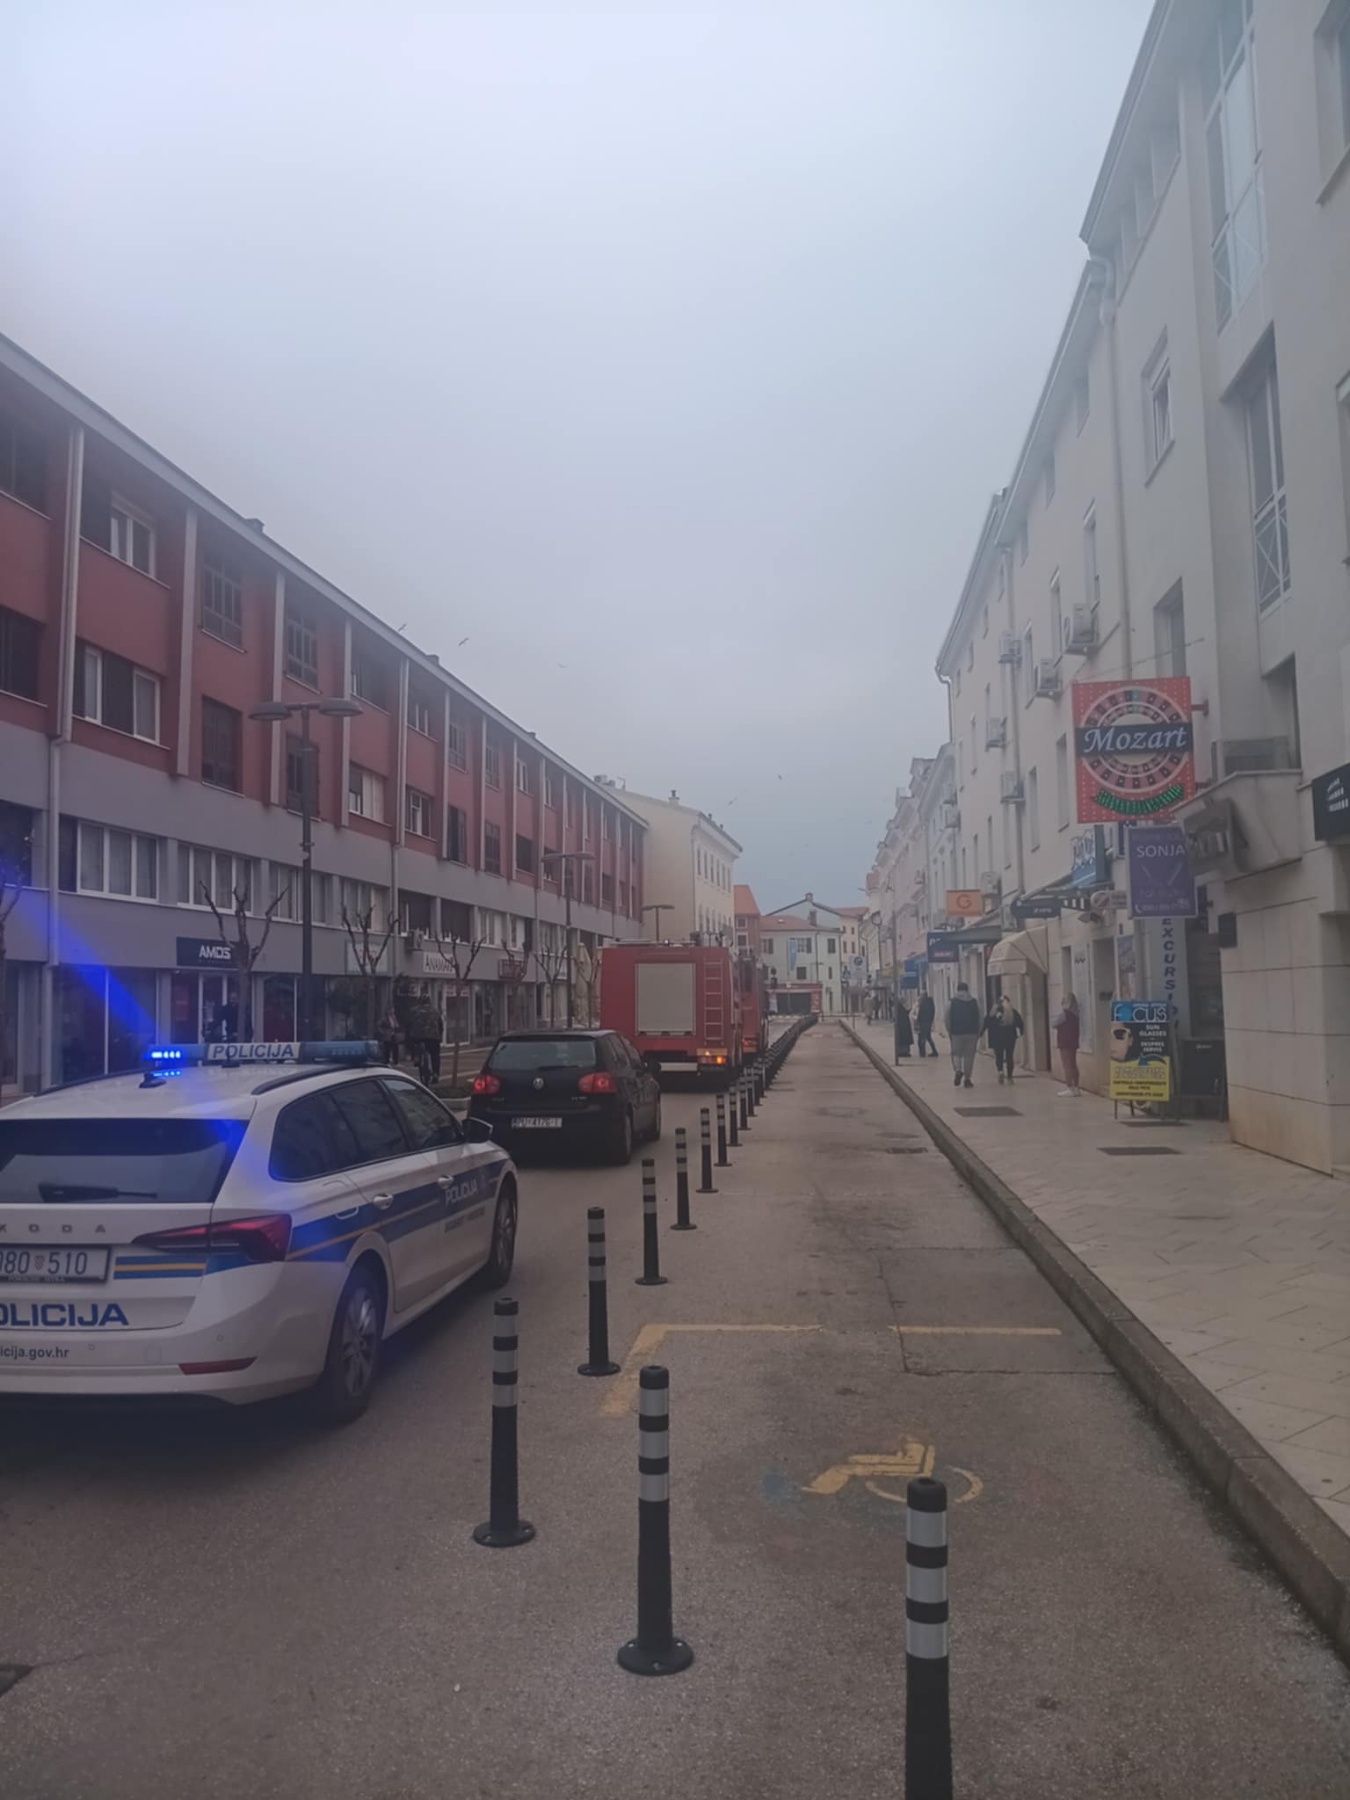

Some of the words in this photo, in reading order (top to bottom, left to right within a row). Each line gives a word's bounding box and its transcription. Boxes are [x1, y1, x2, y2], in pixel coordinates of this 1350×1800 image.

[1083, 726, 1187, 753] Mozart
[1136, 845, 1185, 858] SONJA
[213, 1044, 293, 1059] POLICIJA
[48, 1251, 88, 1275] 510
